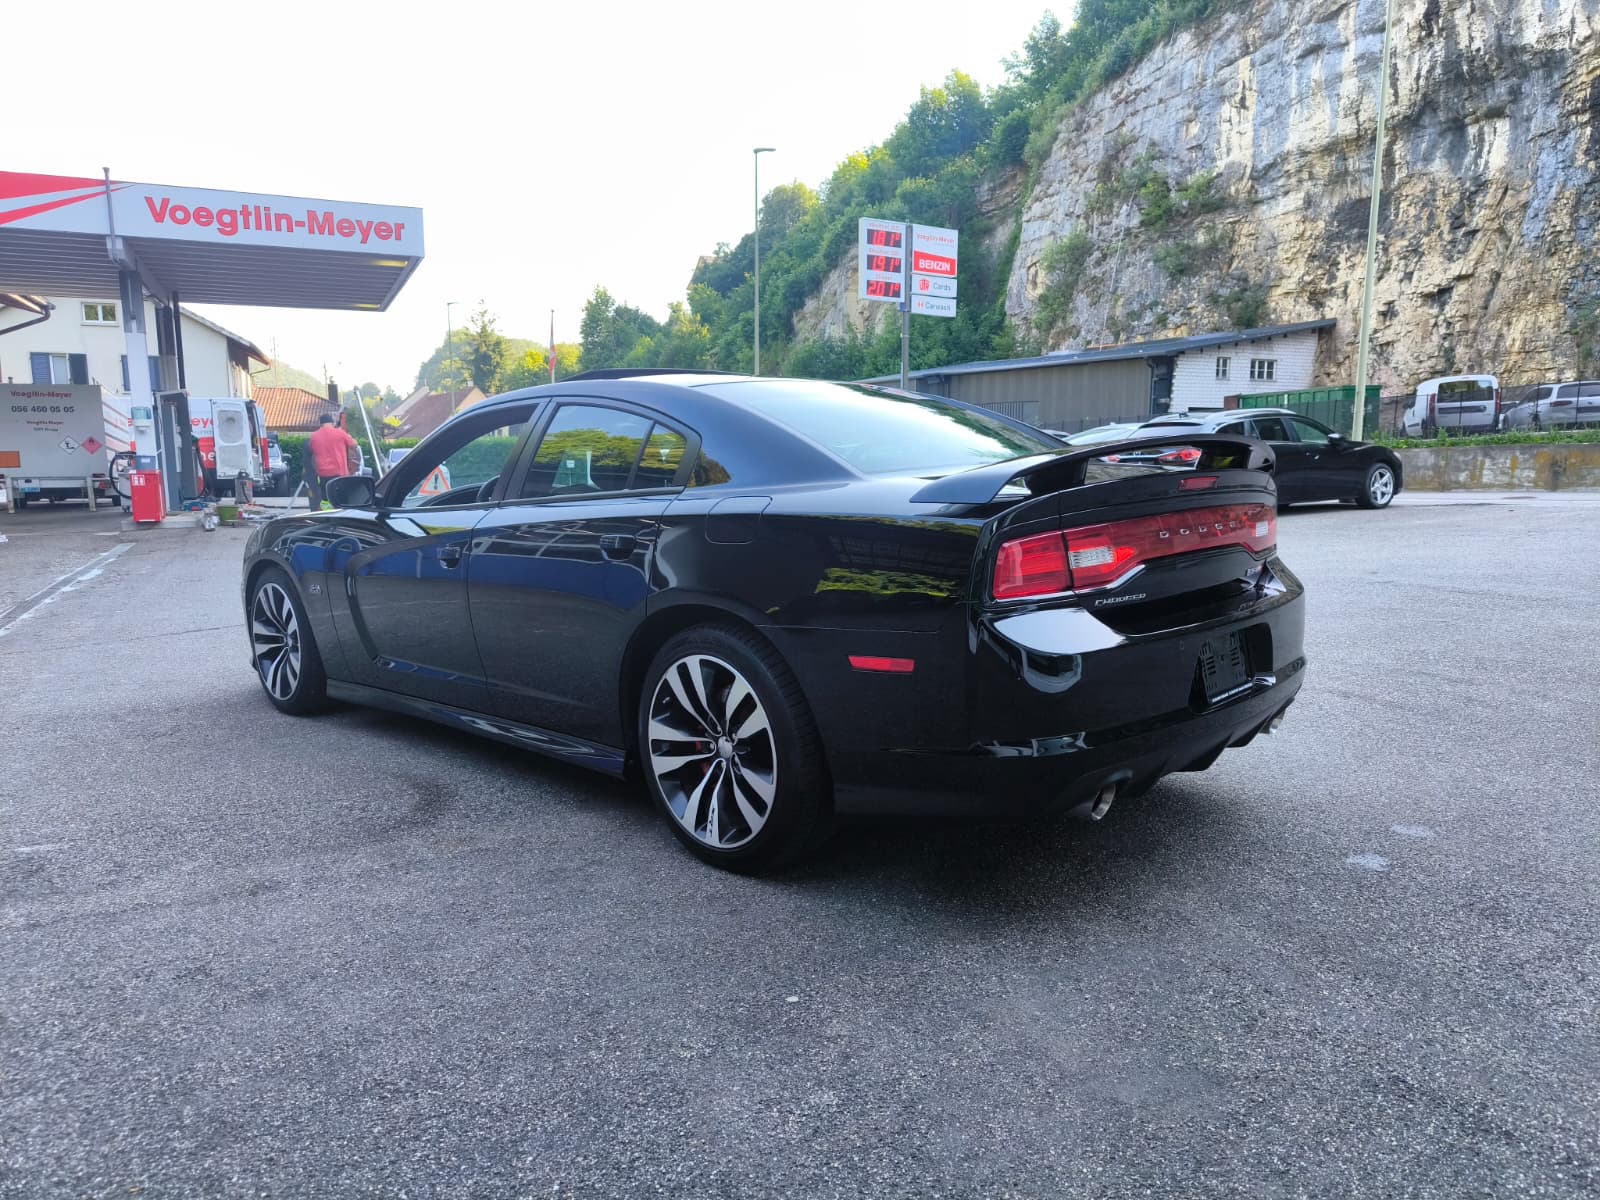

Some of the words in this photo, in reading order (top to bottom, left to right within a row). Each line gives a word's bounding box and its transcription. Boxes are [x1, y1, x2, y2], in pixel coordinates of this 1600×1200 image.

[144, 196, 405, 244] Voegtlin-Meyer
[919, 258, 951, 272] BENZIN
[11, 405, 28, 413] 056
[1159, 521, 1236, 538] DODGE
